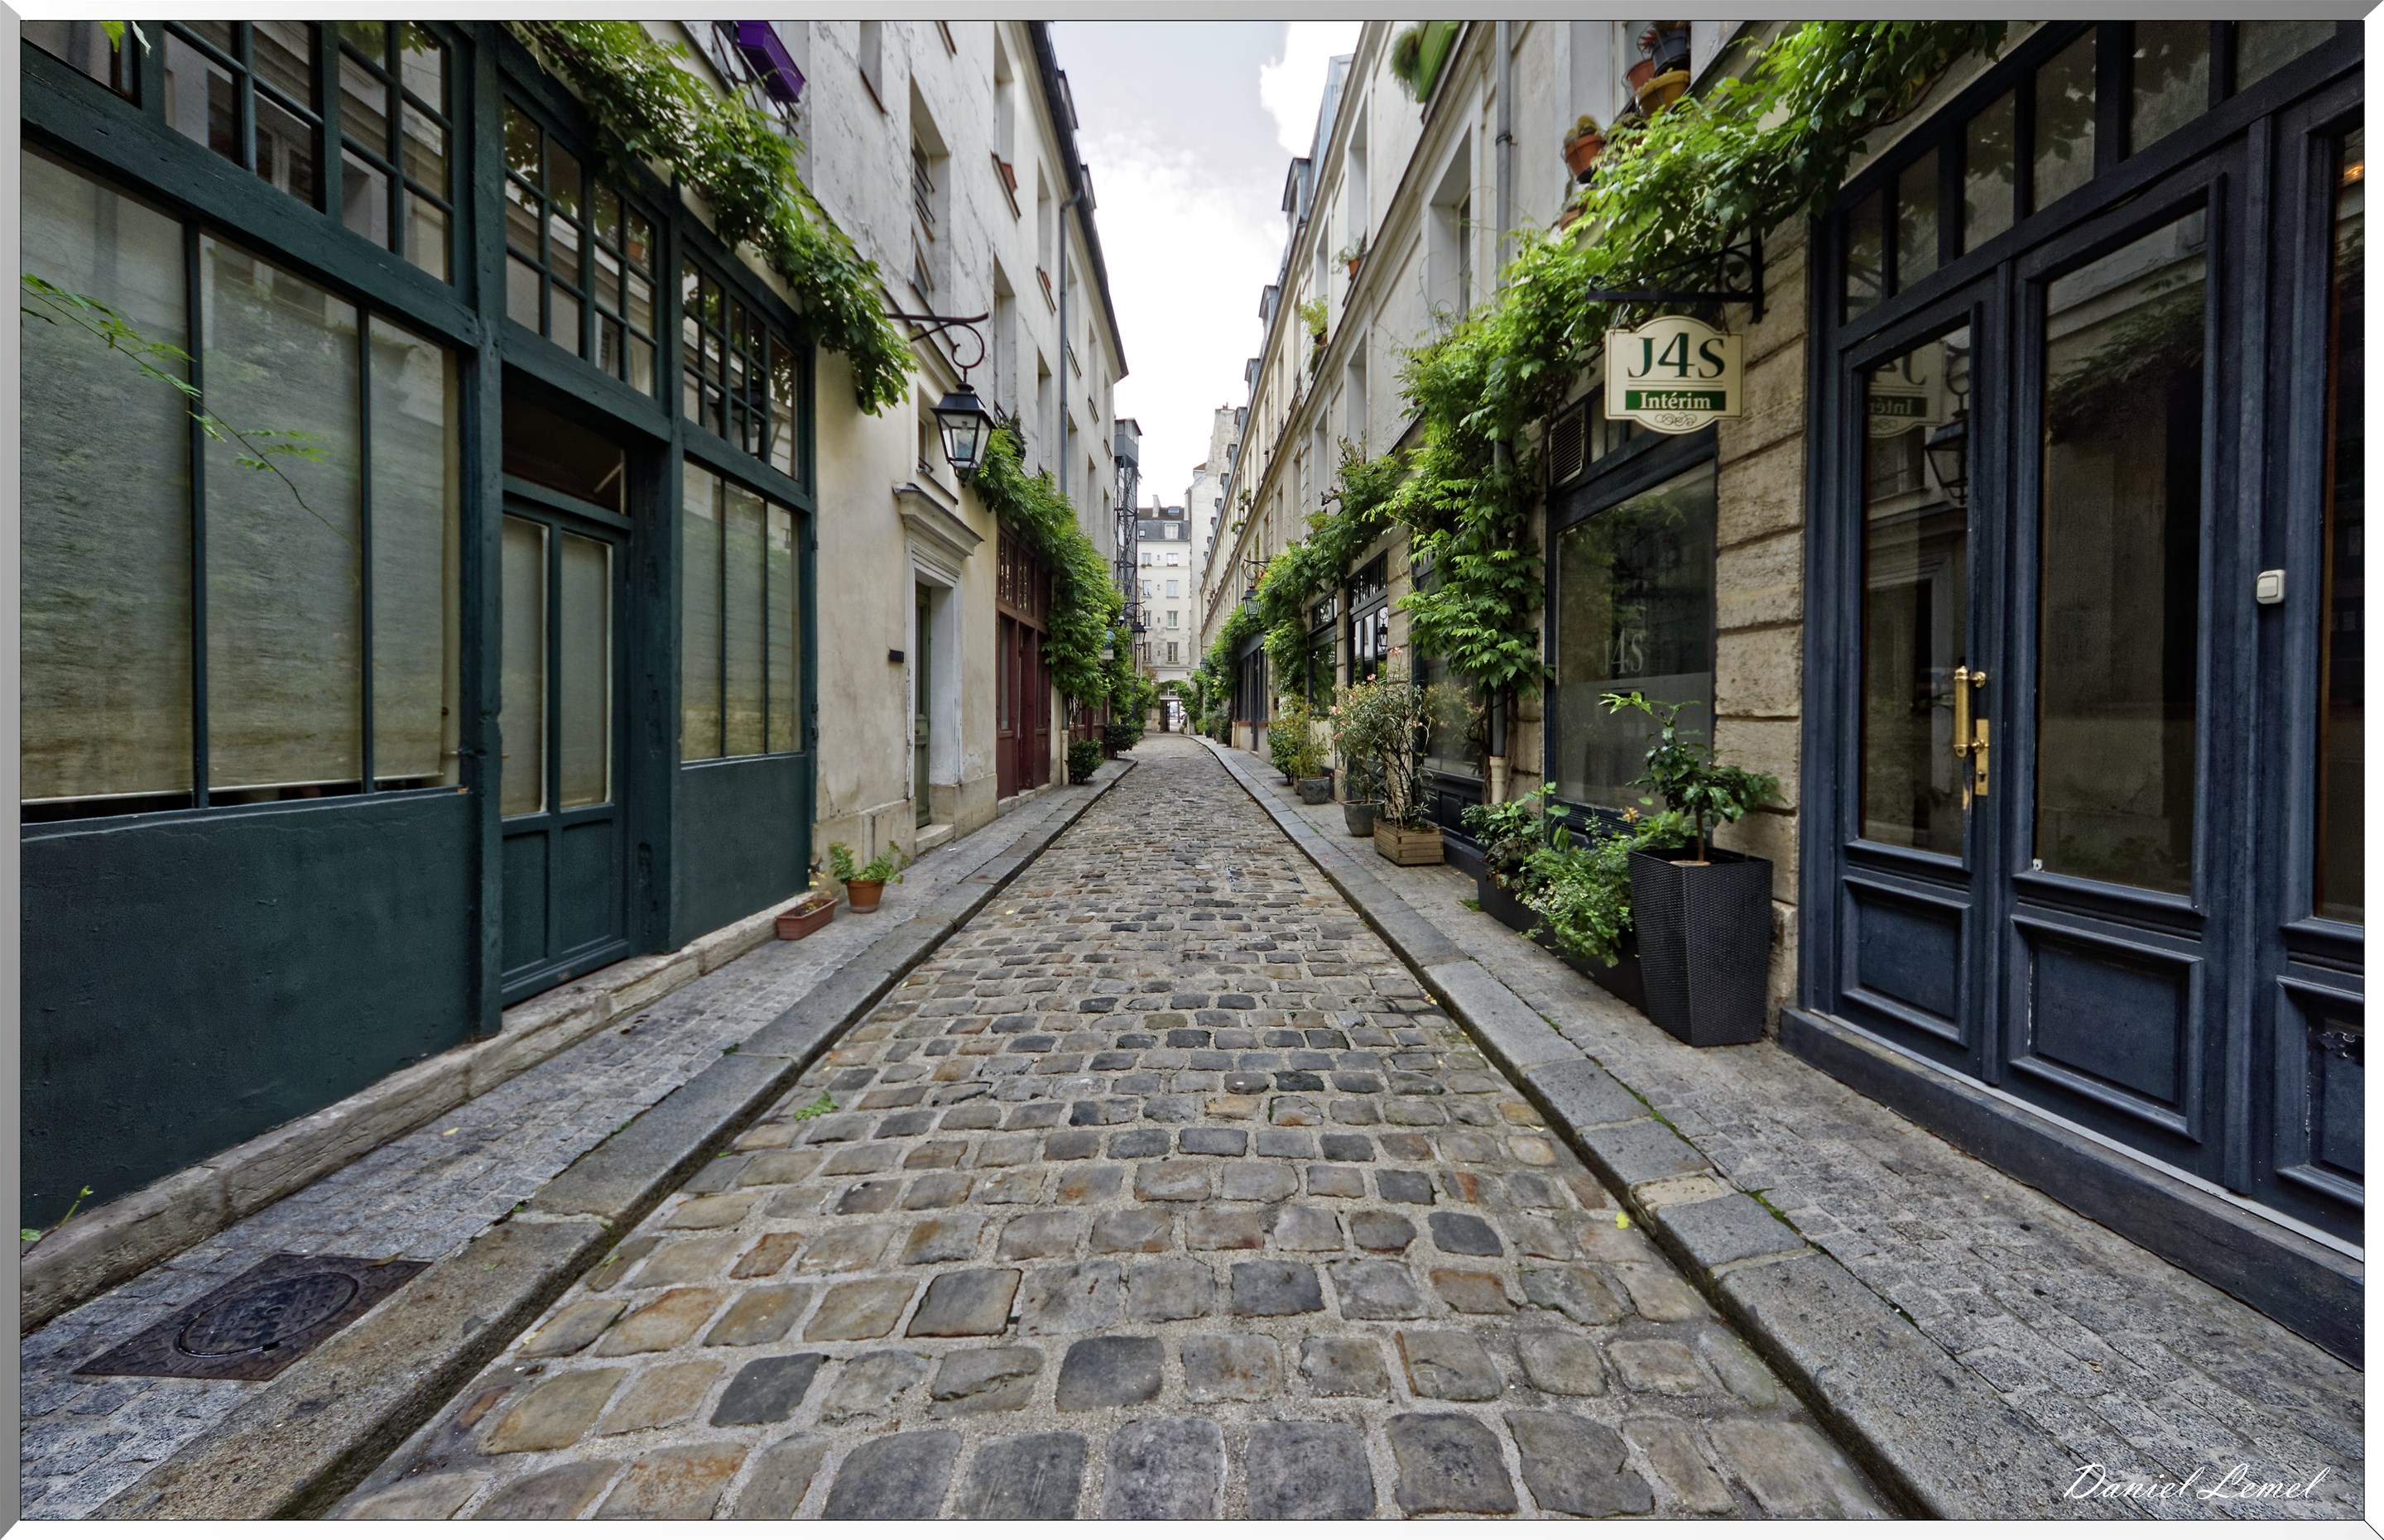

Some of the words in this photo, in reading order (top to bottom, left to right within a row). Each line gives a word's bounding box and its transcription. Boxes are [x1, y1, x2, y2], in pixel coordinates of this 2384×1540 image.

[1627, 332, 1725, 378] J4S
[1639, 391, 1711, 410] Intérim
[1600, 627, 1644, 676] J4S
